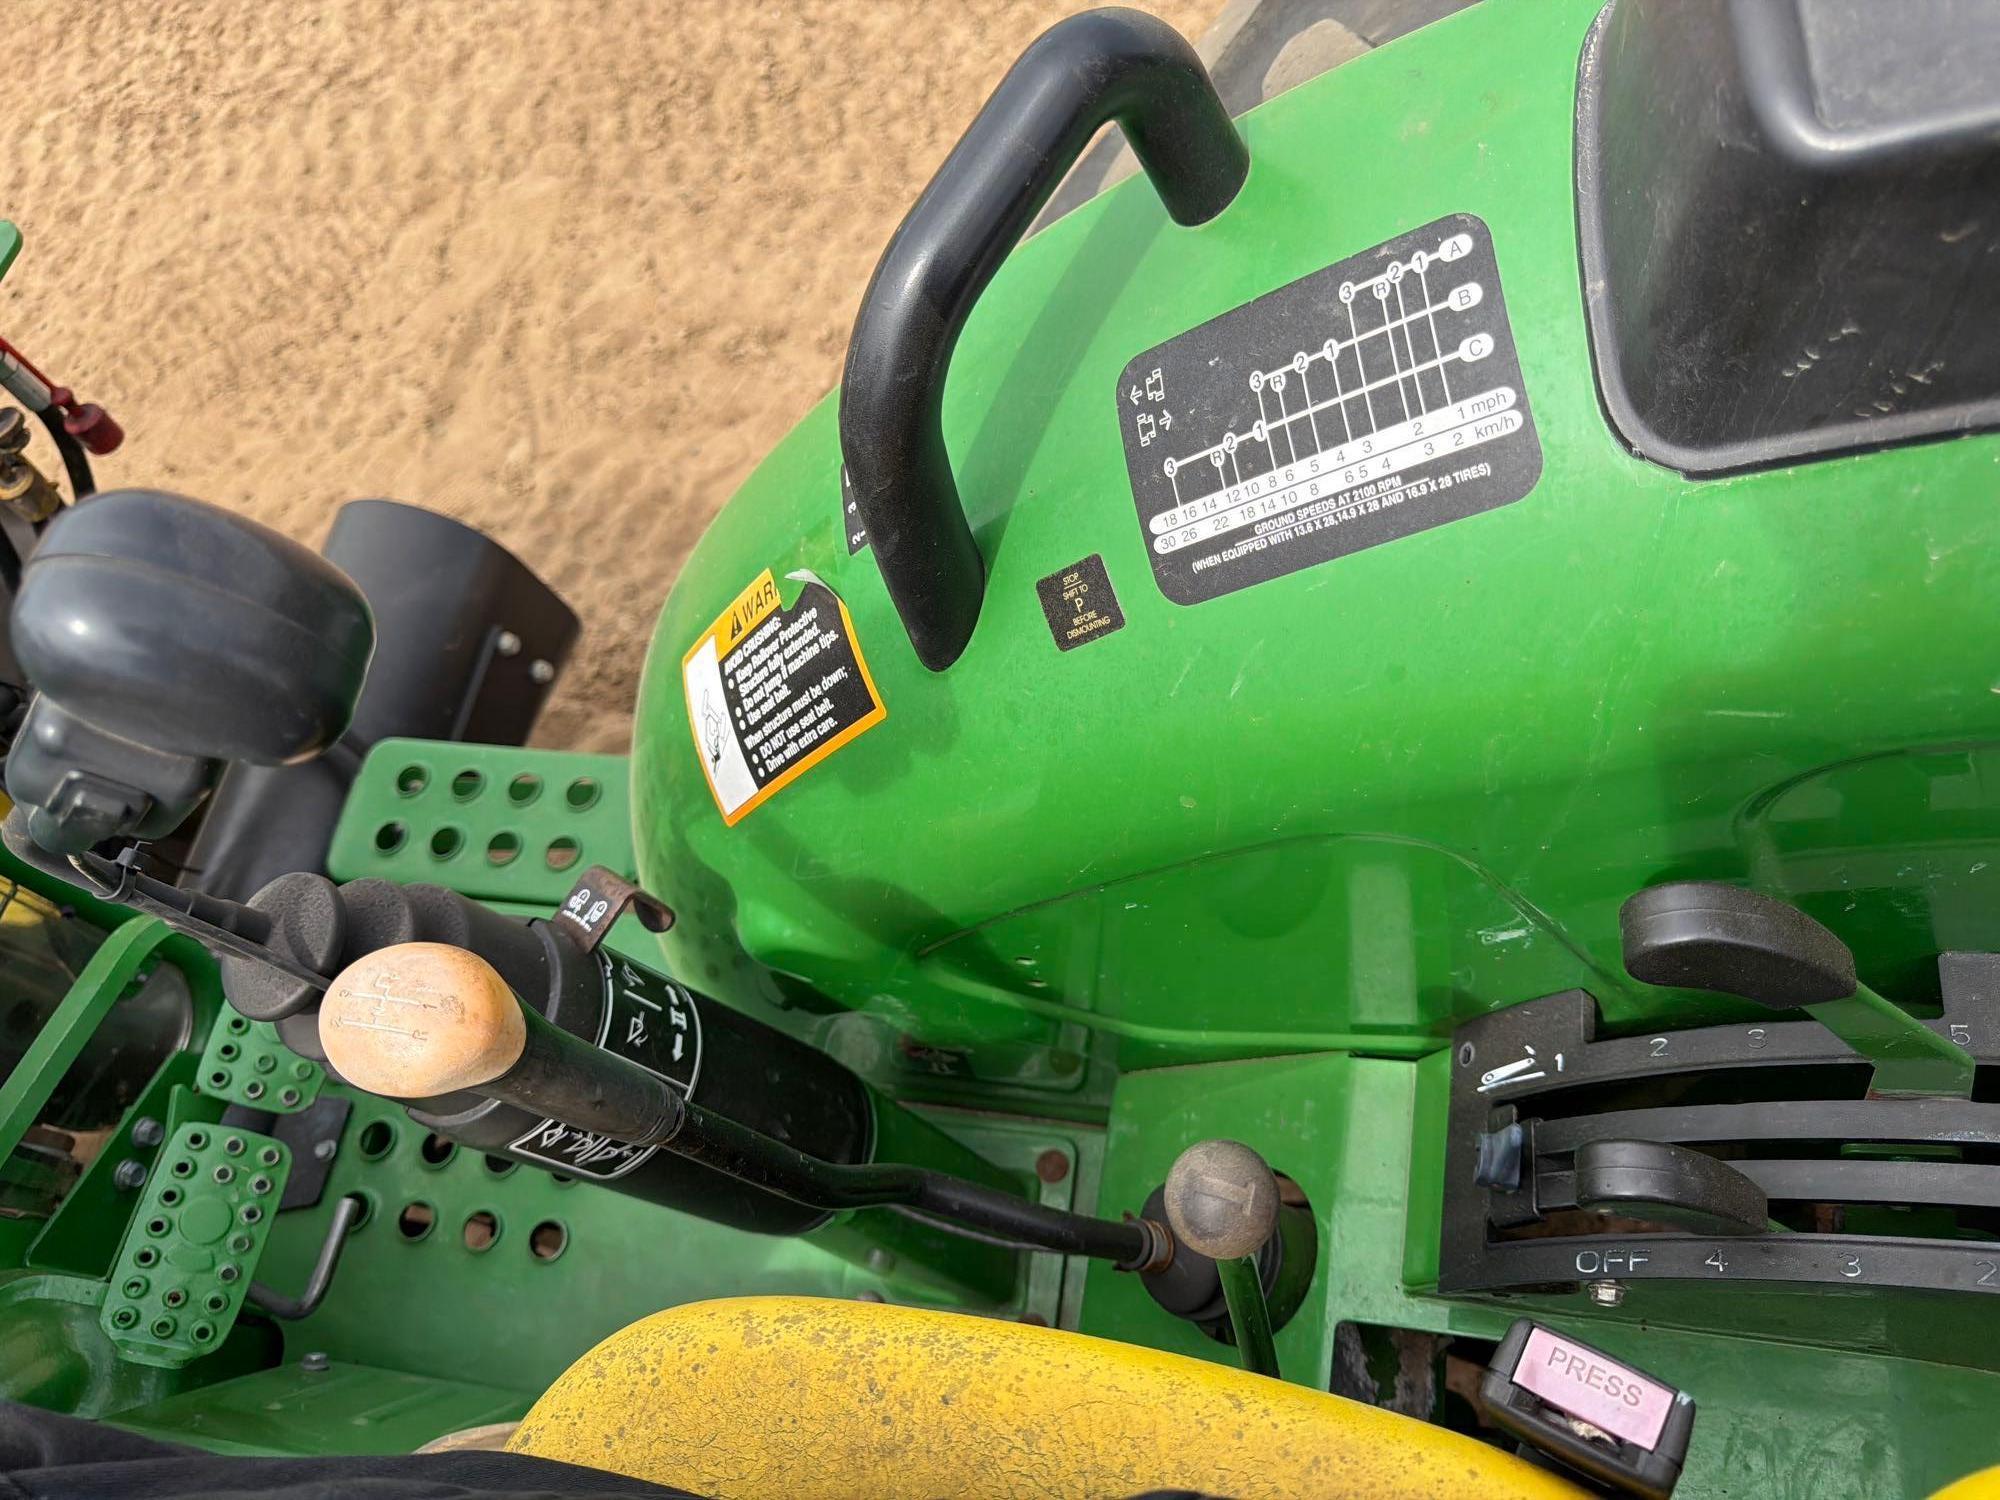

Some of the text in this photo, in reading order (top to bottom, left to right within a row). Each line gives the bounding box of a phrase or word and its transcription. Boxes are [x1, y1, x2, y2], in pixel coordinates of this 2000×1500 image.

[1342, 241, 1463, 299] 3 R 2 1 A
[1253, 289, 1471, 388] 3 R 2 1 B
[1167, 340, 1483, 475] 3 R 2 1 C
[1160, 416, 1515, 550] 30 26 22 18 14 10 8 6 5 4 3 2 km/h
[1163, 392, 1507, 528] 18 16 14 12 10 8 6 5 4 3 2 1 mph
[1191, 553, 1222, 575] (WHEN
[1222, 538, 1267, 562] EQUIPPED
[1268, 530, 1294, 546] WITH
[1314, 519, 1324, 531] X
[1357, 504, 1366, 516] X
[1368, 500, 1380, 512] 28
[1381, 493, 1404, 508] AND
[1428, 480, 1438, 493] X
[1438, 476, 1453, 488] 28
[1452, 462, 1491, 484] TIRES)
[1254, 475, 1402, 536] GROUND SPEEDS AT 2100 RPM
[742, 581, 778, 624] WAR
[1062, 572, 1079, 586] STOP
[1062, 584, 1089, 601] SHIFT TO
[1075, 597, 1084, 613] P
[735, 663, 753, 684] Keep
[778, 607, 818, 645] Protective
[1066, 616, 1111, 640] DISMOUNTING
[1072, 610, 1098, 626] BEFORE
[739, 666, 769, 698] Structure
[783, 621, 820, 660] extended.
[742, 697, 754, 712] Do
[752, 685, 766, 704] not
[762, 673, 782, 697] jump
[787, 642, 820, 675] machine
[819, 629, 839, 649] tips.
[744, 730, 764, 750] When
[762, 707, 793, 736] structure
[791, 690, 812, 713] must
[809, 684, 822, 699] be
[746, 683, 791, 725] Use seat belt.
[760, 697, 835, 759] DO NOT use seat belt.
[765, 717, 838, 773] Drive with extra care.
[1555, 1025, 1971, 1072] 1 2 3 5
[1575, 1249, 1999, 1287] OFF 4 3 2
[1547, 1346, 1643, 1407] PRESS
